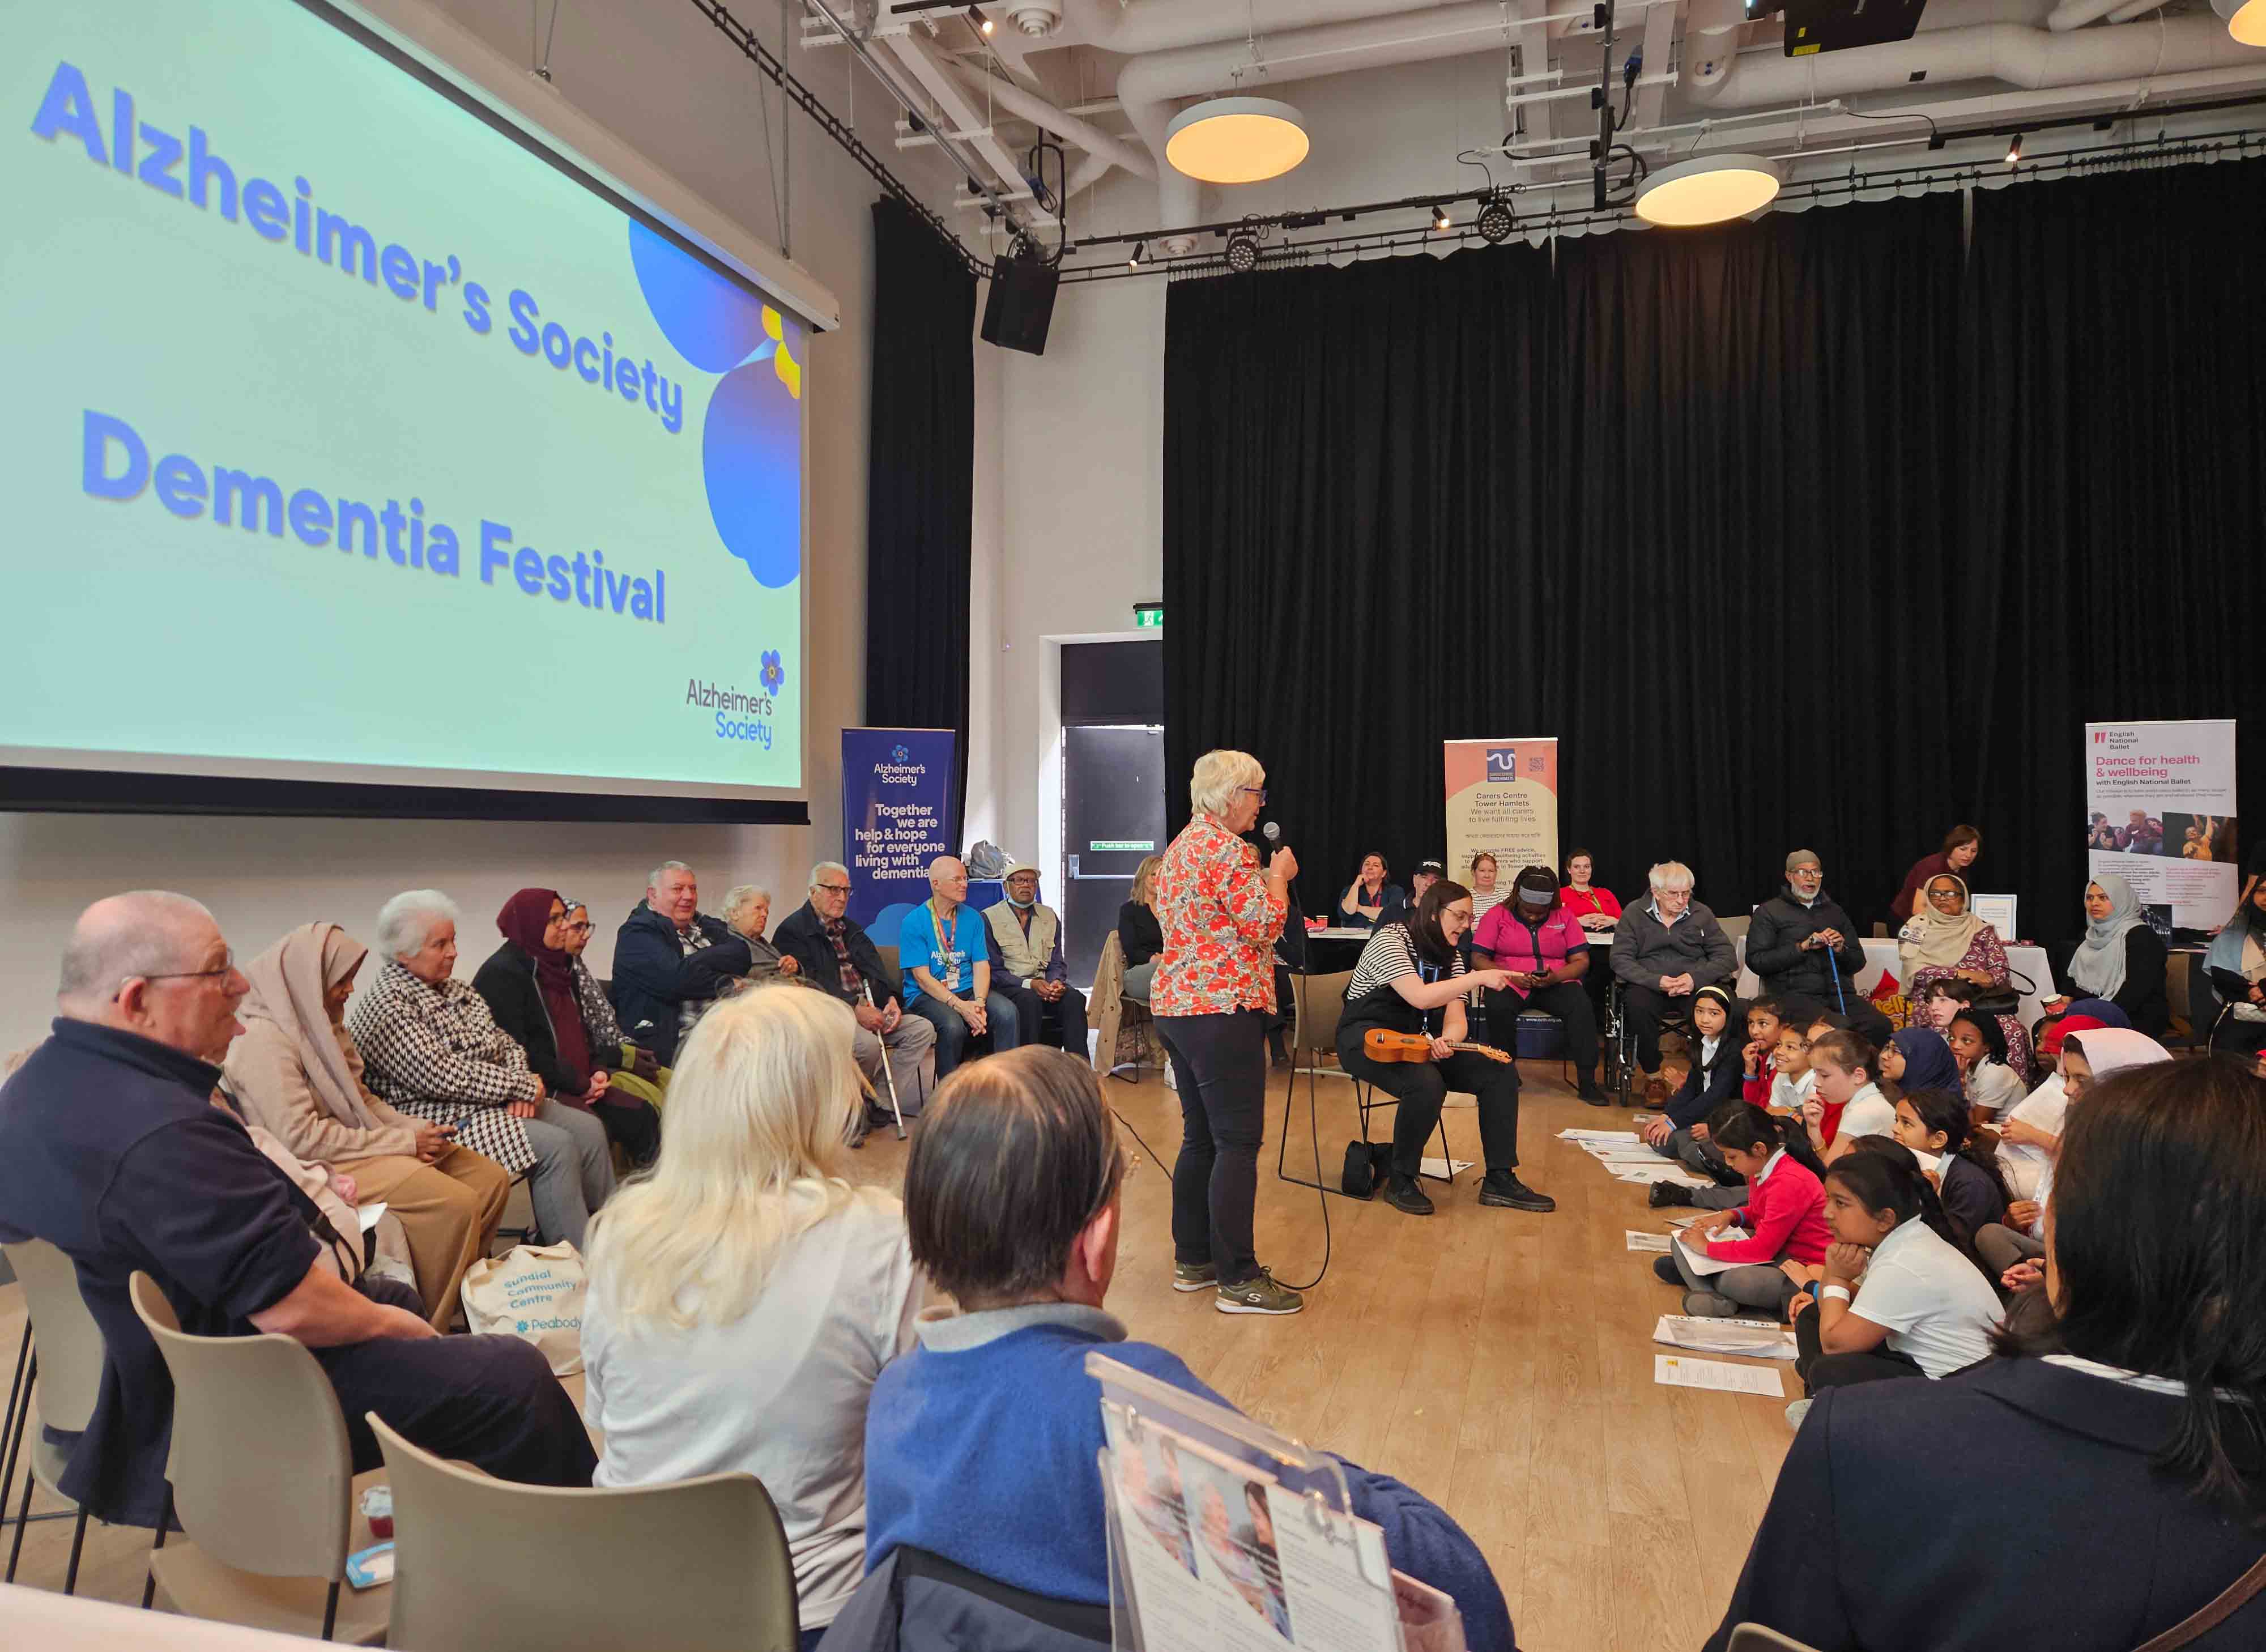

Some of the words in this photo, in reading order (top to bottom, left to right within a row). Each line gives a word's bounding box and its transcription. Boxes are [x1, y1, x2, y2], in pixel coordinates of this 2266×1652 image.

[30, 61, 492, 333] Alzheimer's
[508, 289, 683, 434] Society
[82, 408, 459, 576] Dementia
[479, 519, 665, 623] Festival
[686, 679, 773, 716] Alzheimer's
[715, 711, 772, 750] Society
[2096, 756, 2135, 765] Dance
[2139, 756, 2156, 765] for
[2159, 755, 2200, 764] health
[874, 763, 926, 774] Alzheimer's
[2096, 768, 2105, 777] &
[2108, 767, 2167, 778] wellbeing
[882, 774, 917, 786] Society
[875, 803, 933, 818] Together
[897, 819, 917, 828] we
[918, 819, 938, 828] are
[855, 828, 883, 842] help
[884, 829, 895, 841] &
[895, 828, 928, 842] hope
[866, 841, 884, 854] for
[887, 842, 945, 855] everyone
[855, 854, 889, 868] living
[891, 854, 919, 866] with
[872, 867, 929, 880] dementia
[504, 1268, 552, 1288] Sundial
[507, 1280, 577, 1297] Community
[510, 1295, 553, 1309] Centre
[531, 1315, 582, 1331] Peabody
